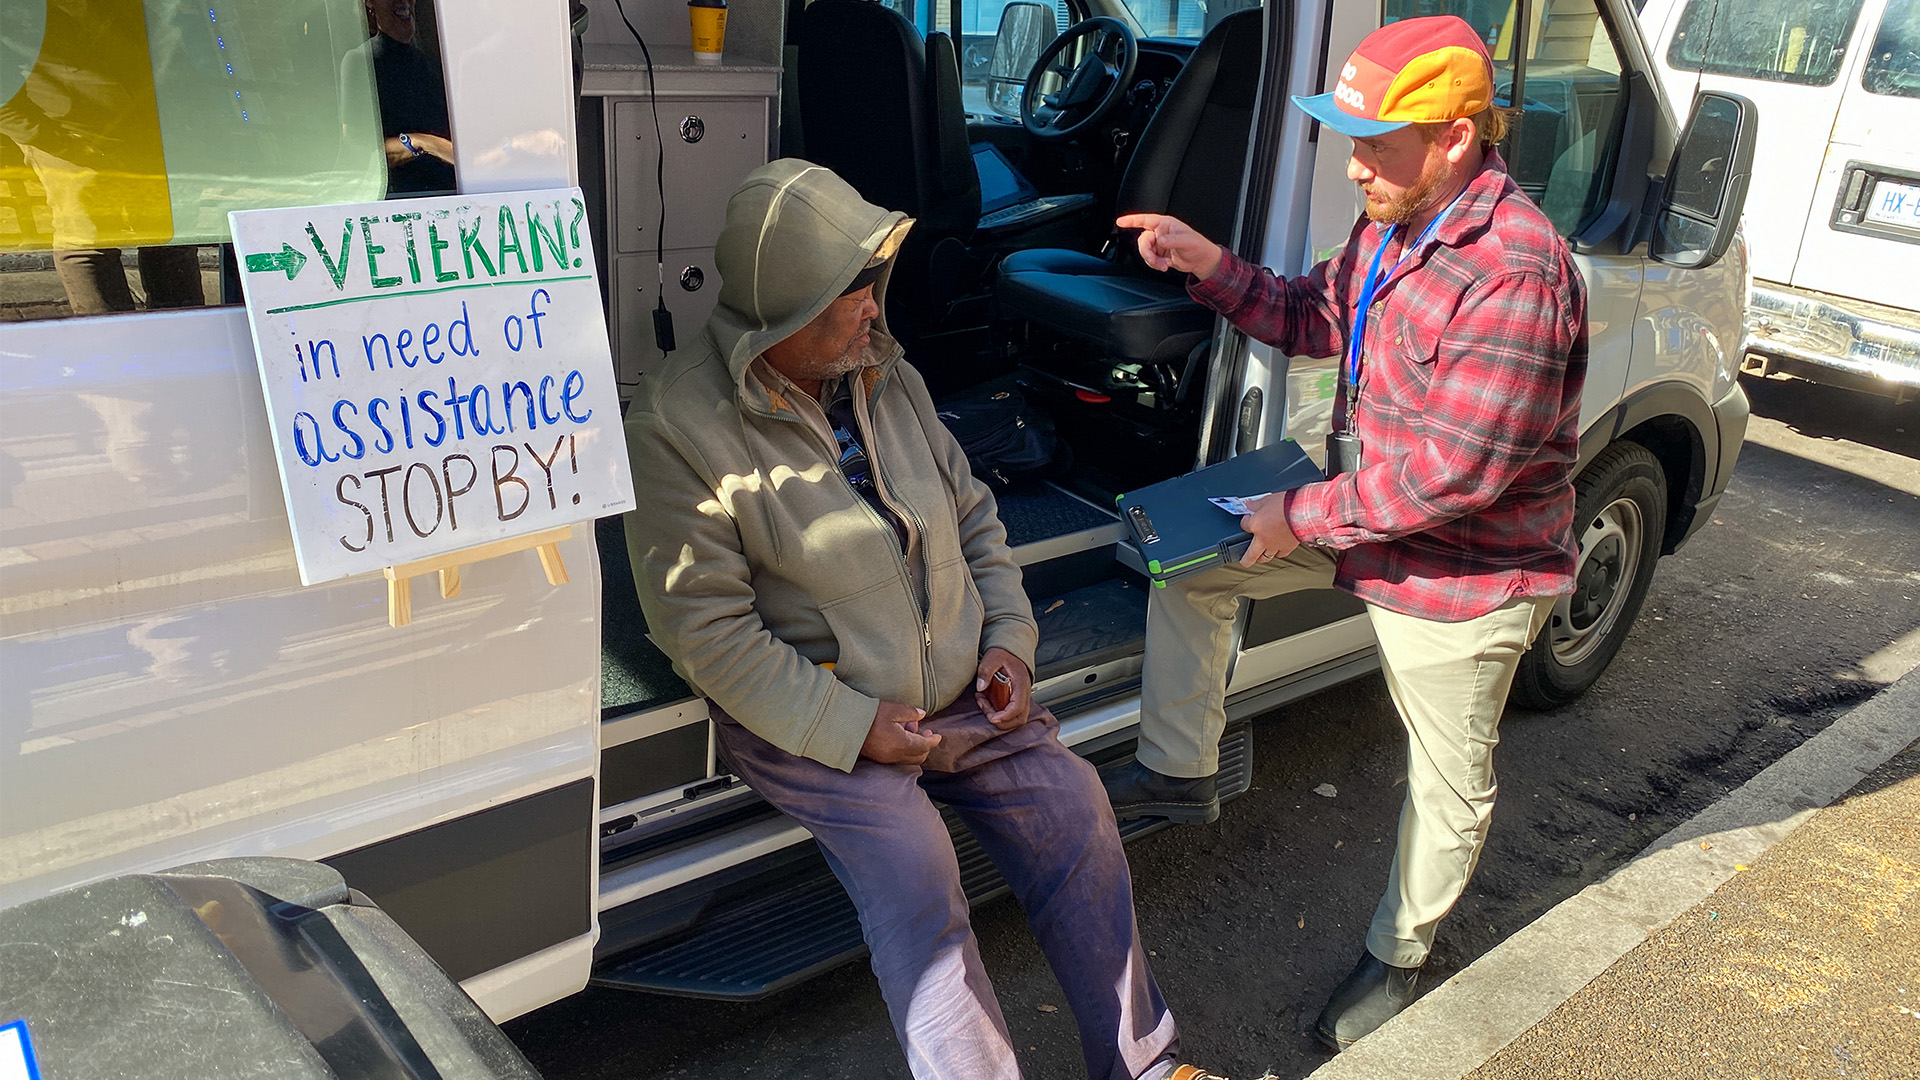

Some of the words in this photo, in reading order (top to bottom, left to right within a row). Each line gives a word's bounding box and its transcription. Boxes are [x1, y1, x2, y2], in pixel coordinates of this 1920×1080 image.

[292, 332, 341, 382] in
[363, 301, 479, 371] need
[504, 289, 551, 350] of
[293, 370, 592, 467] assistance
[336, 454, 477, 552] STOP
[491, 434, 580, 522] BY!
